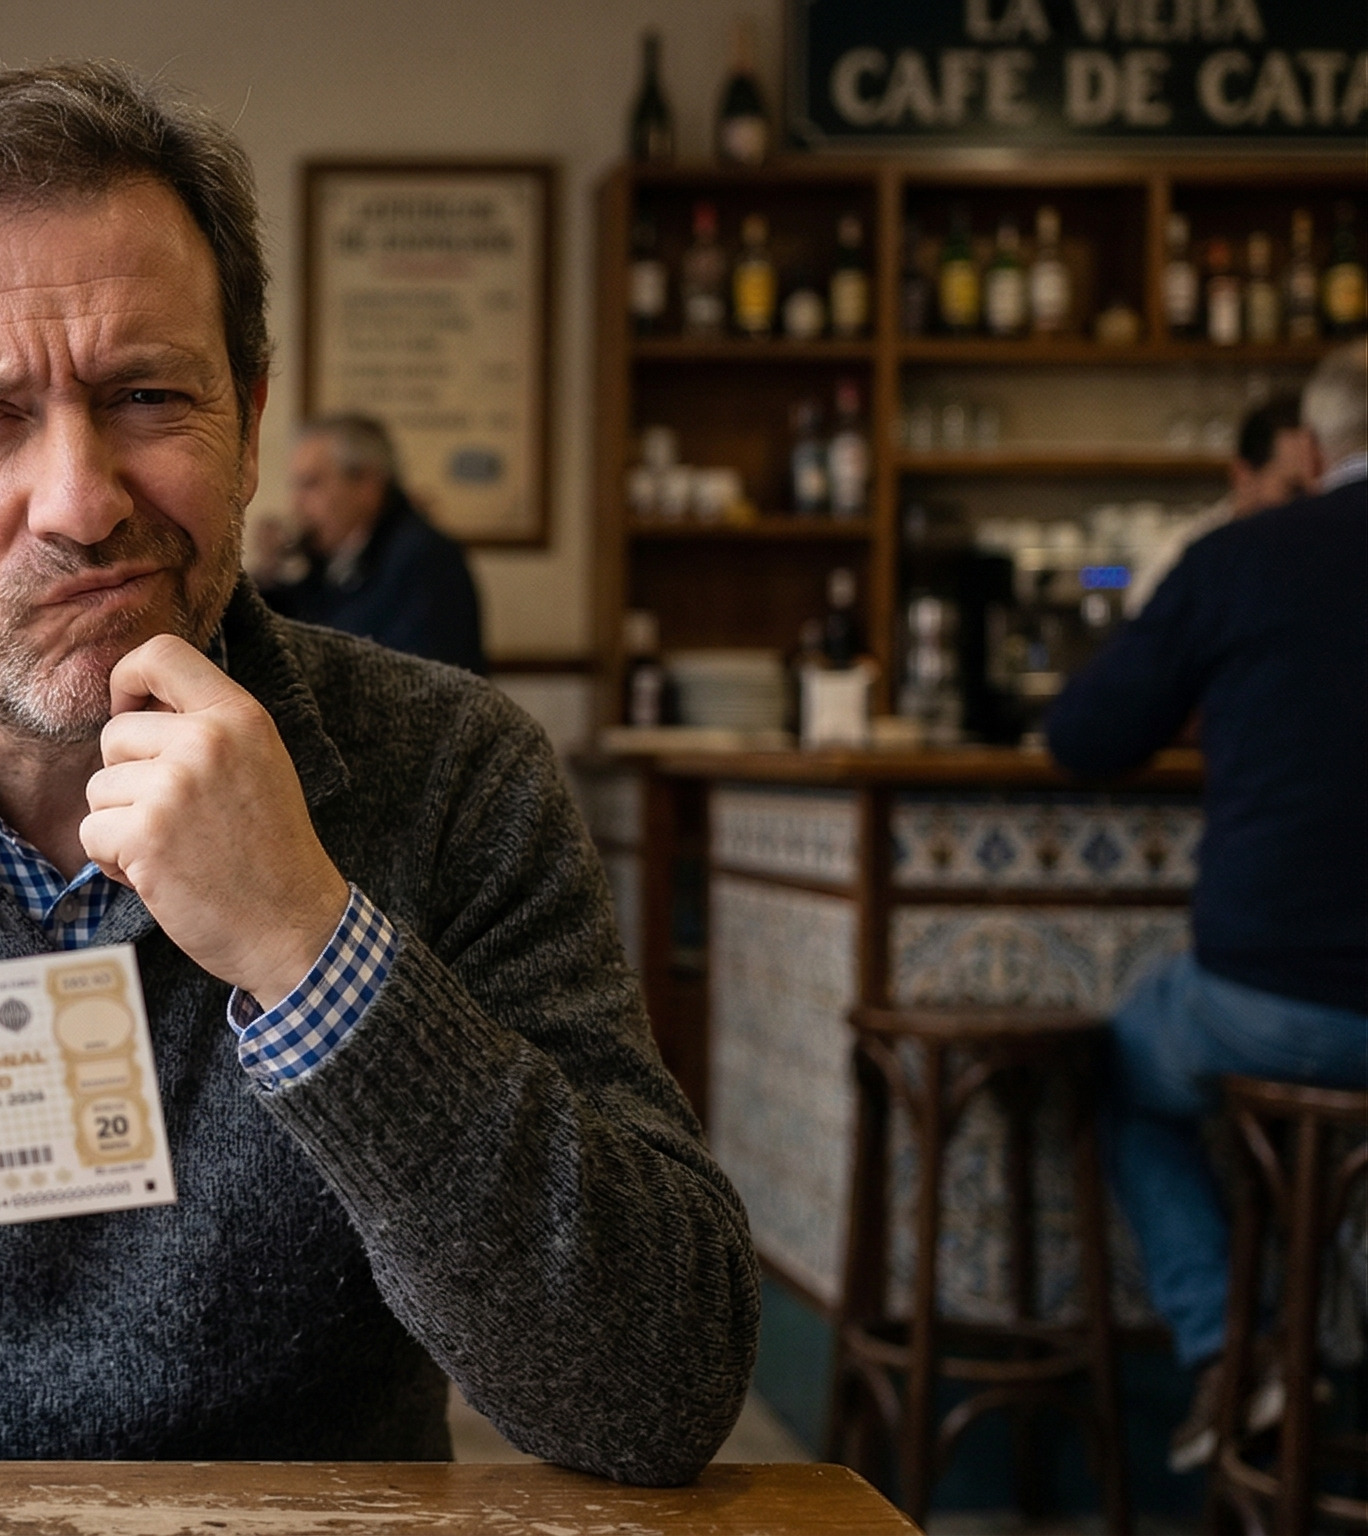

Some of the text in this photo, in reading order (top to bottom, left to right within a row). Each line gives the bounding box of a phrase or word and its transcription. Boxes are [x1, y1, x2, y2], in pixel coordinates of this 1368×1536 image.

[962, 0, 1050, 43] LA
[831, 46, 1035, 126] CAFE
[1063, 48, 1173, 126] DE
[95, 1114, 130, 1139] 20
